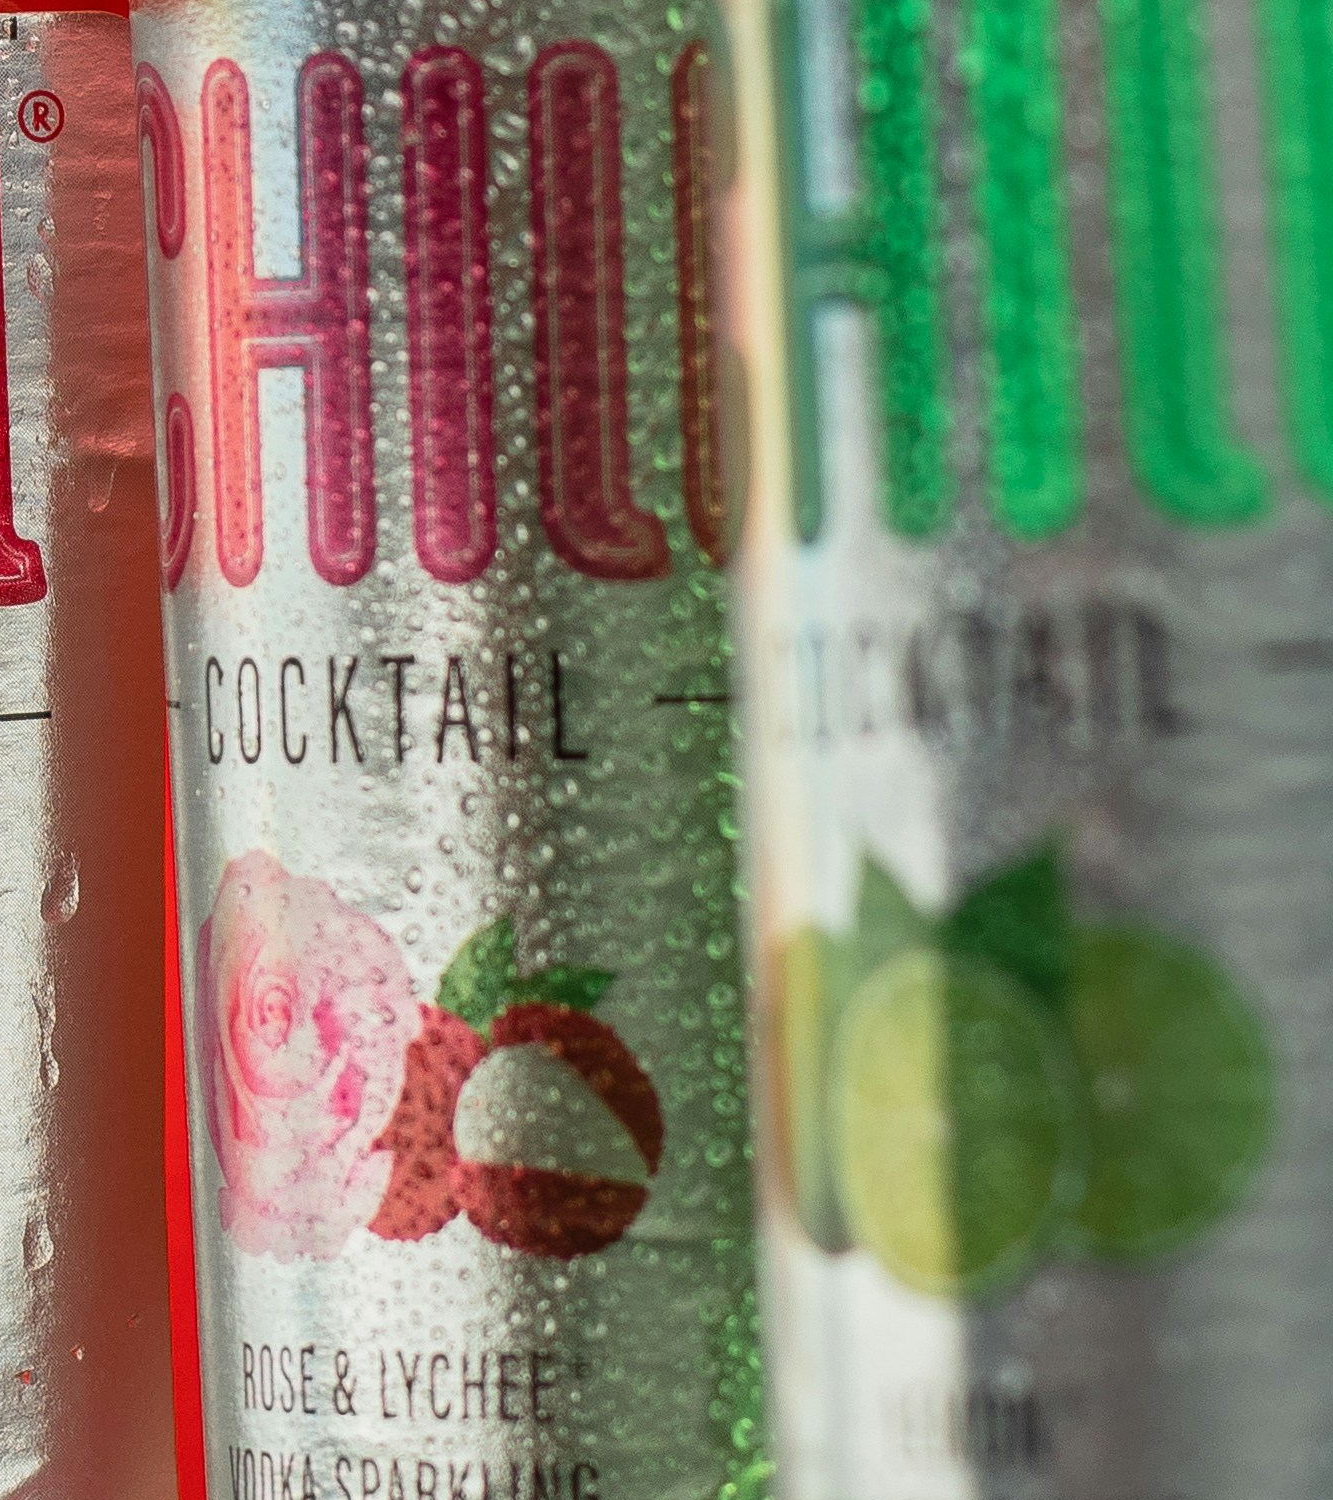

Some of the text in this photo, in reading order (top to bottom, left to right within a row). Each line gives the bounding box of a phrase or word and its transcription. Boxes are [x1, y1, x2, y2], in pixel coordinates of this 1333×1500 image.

[205, 649, 591, 766] COCKTAIL
[242, 1341, 318, 1415] ROSE
[333, 1349, 357, 1416] &
